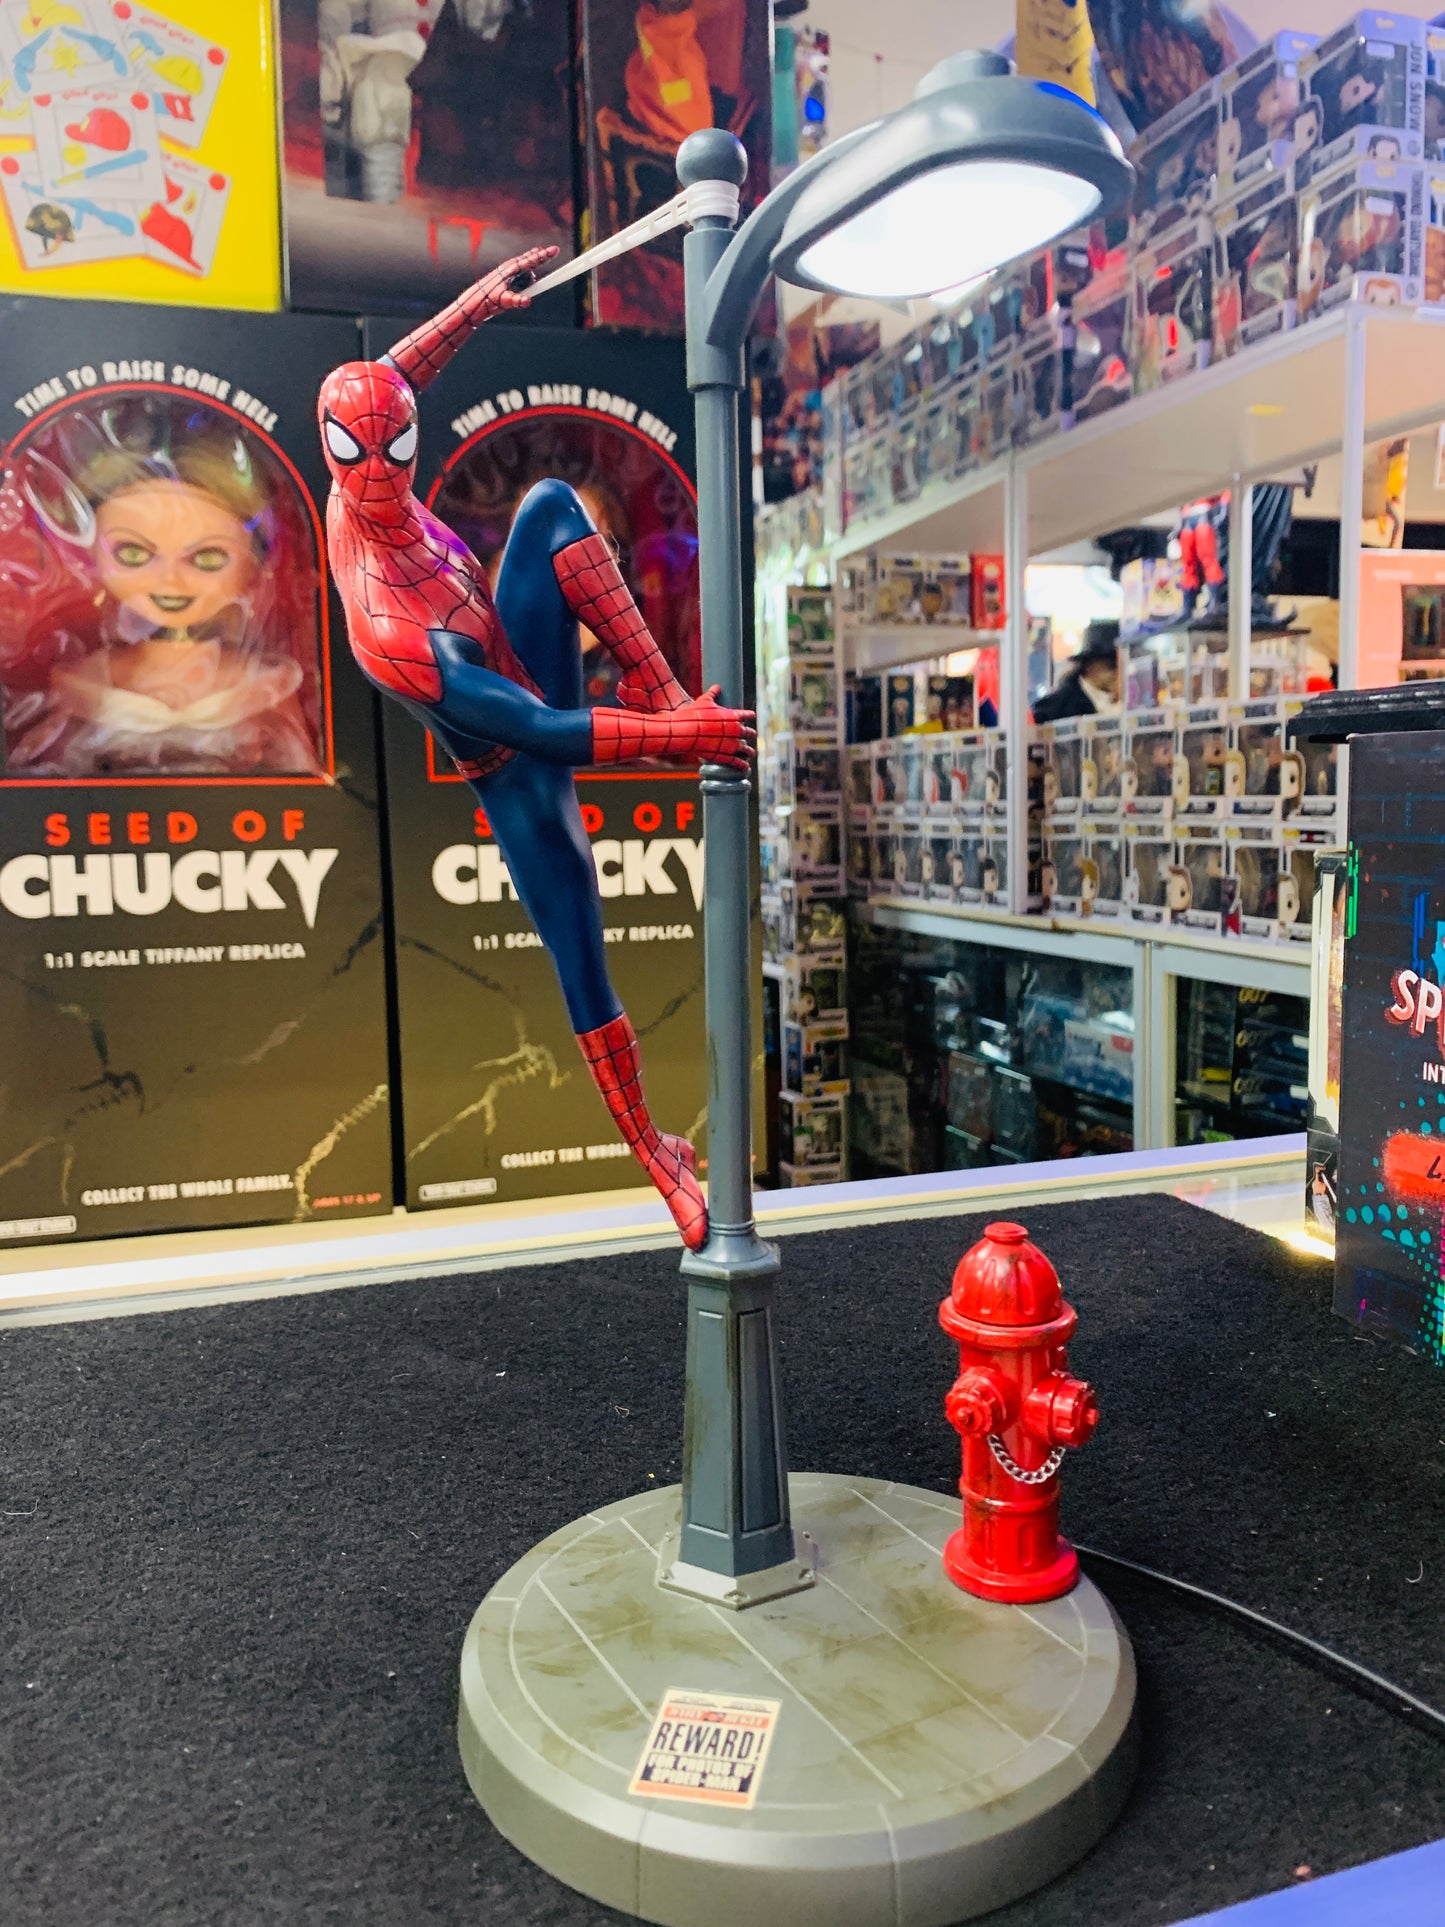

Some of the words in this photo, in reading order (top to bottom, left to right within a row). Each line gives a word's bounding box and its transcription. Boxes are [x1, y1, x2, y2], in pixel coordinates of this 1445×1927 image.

[428, 215, 500, 268] IT
[15, 377, 67, 418] TIME
[66, 366, 97, 389] TO
[102, 360, 165, 382] RAISE
[171, 365, 231, 401] SOME
[232, 390, 279, 432] HELL
[451, 400, 498, 438] TIME
[497, 389, 524, 413] TO
[527, 384, 582, 406] RAISE
[587, 388, 638, 423] SOME
[45, 811, 198, 847] SEED
[233, 809, 305, 841] OF
[474, 804, 604, 837] SD
[633, 801, 695, 832] OF
[0, 849, 339, 929] CHUCKY
[432, 837, 704, 912] CHCKY
[43, 952, 74, 969] 1:1
[80, 948, 140, 967] SCALE
[144, 945, 224, 965] TIFFANY
[229, 942, 306, 962] REPLICA
[504, 932, 544, 950] SCAL
[629, 923, 694, 942] REPLICA
[1390, 970, 1445, 1044] SP
[501, 1150, 556, 1169] COLLECT
[558, 1147, 584, 1162] THE
[81, 1186, 145, 1206] COLLECT
[147, 1183, 178, 1200] THE
[179, 1178, 233, 1198] WHOLE
[652, 1721, 765, 1761] REWARD!
